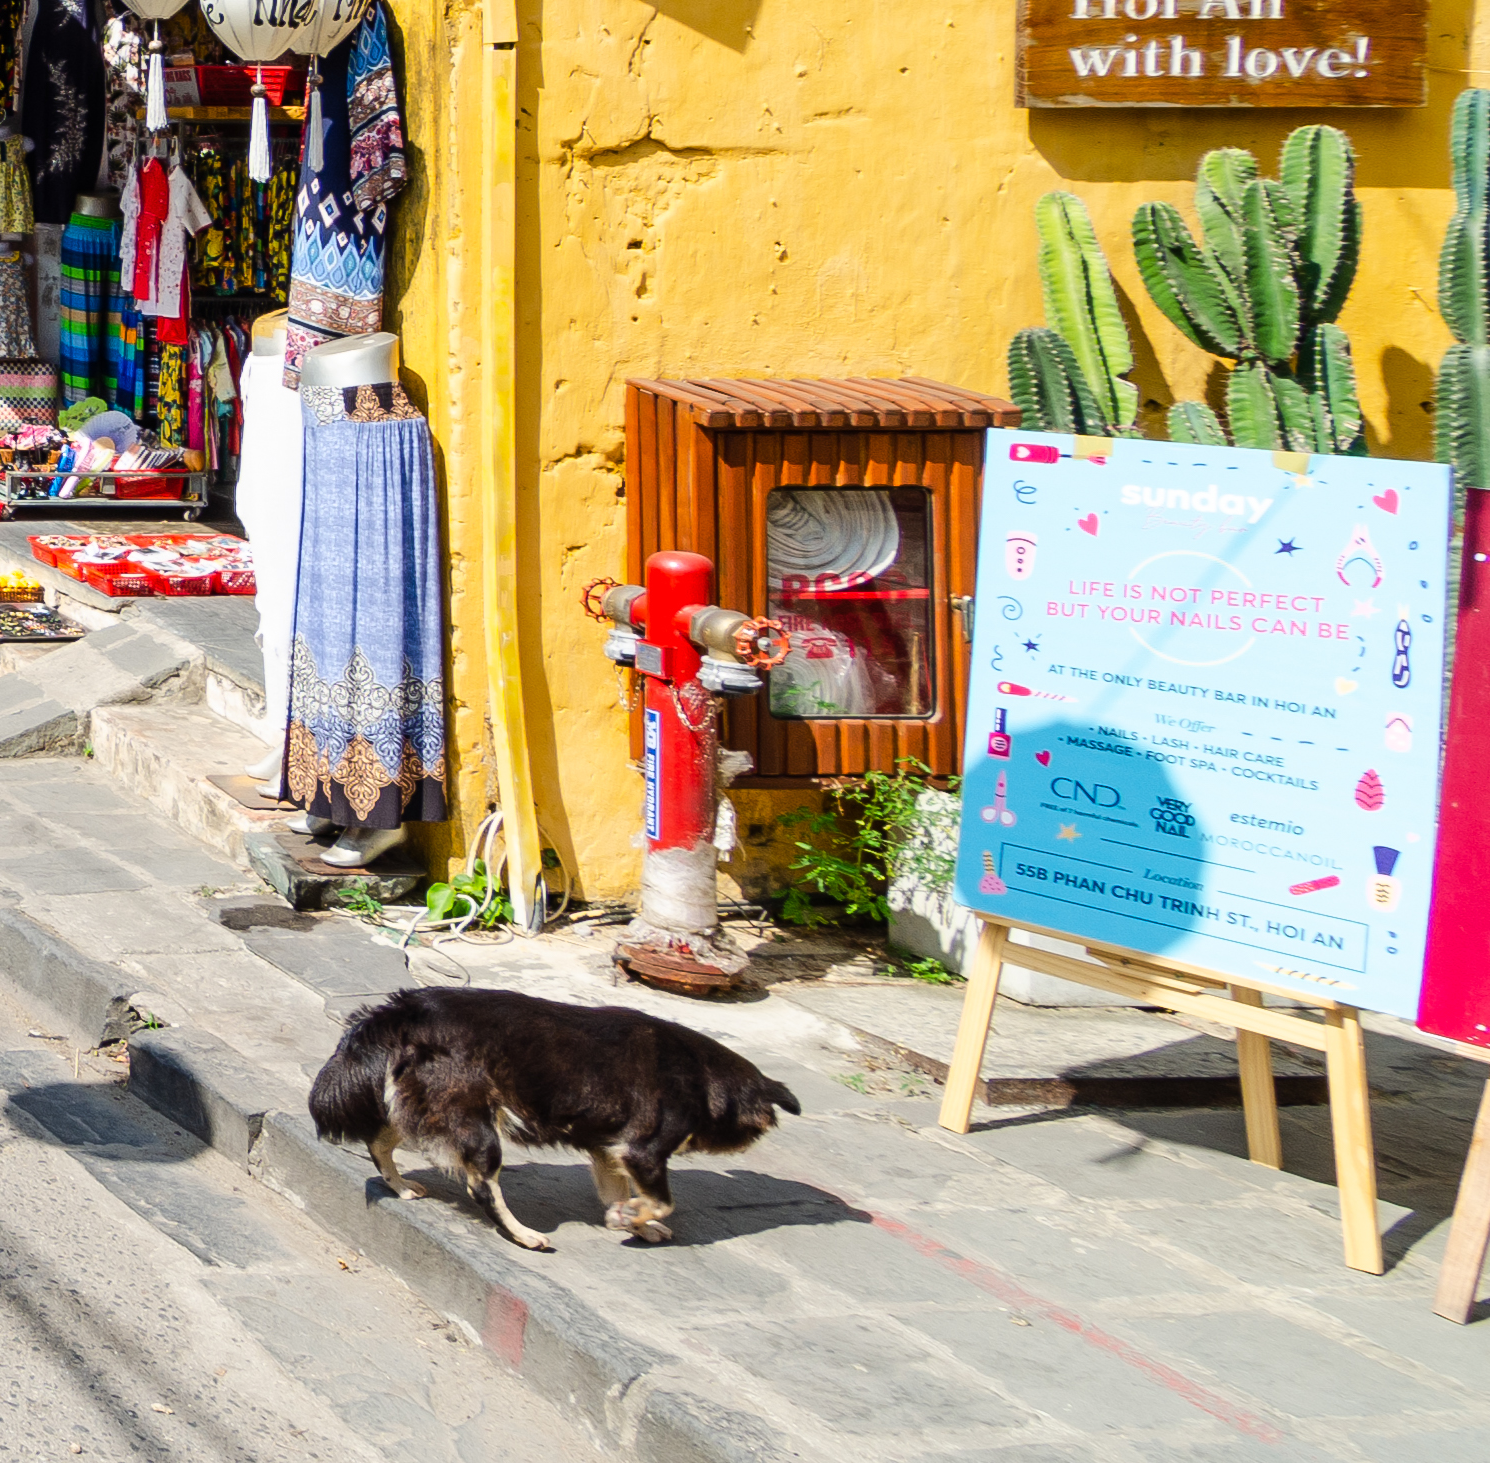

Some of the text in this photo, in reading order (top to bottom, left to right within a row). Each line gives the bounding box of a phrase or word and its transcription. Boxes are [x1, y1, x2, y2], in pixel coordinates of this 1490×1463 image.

[1068, 33, 1371, 79] with love!
[1121, 483, 1273, 524] sunday
[1069, 580, 1325, 613] LIFE IS NOT PERFECT
[1047, 601, 1350, 640] BUT YOUR NAILS CAN BE
[1047, 664, 1336, 719] AT THE ONLY BEAUTY BAR IN HOI AN
[1154, 713, 1216, 734] We Offer
[1066, 736, 1319, 792] MASSAGE FOOT SPA COCKTAILS
[1097, 725, 1285, 768] NAILS LASH HAIR CARE
[645, 753, 656, 833] FIRE HYDRANT
[1050, 777, 1121, 808] CND
[1156, 795, 1193, 813] VERY
[1150, 807, 1196, 827] GOOD
[1155, 820, 1191, 839] NAIL
[1230, 811, 1305, 836] estemio
[1143, 868, 1204, 892] Location
[1015, 863, 1344, 950] 55B PHAN CHU TRINH ST., HOI AN
